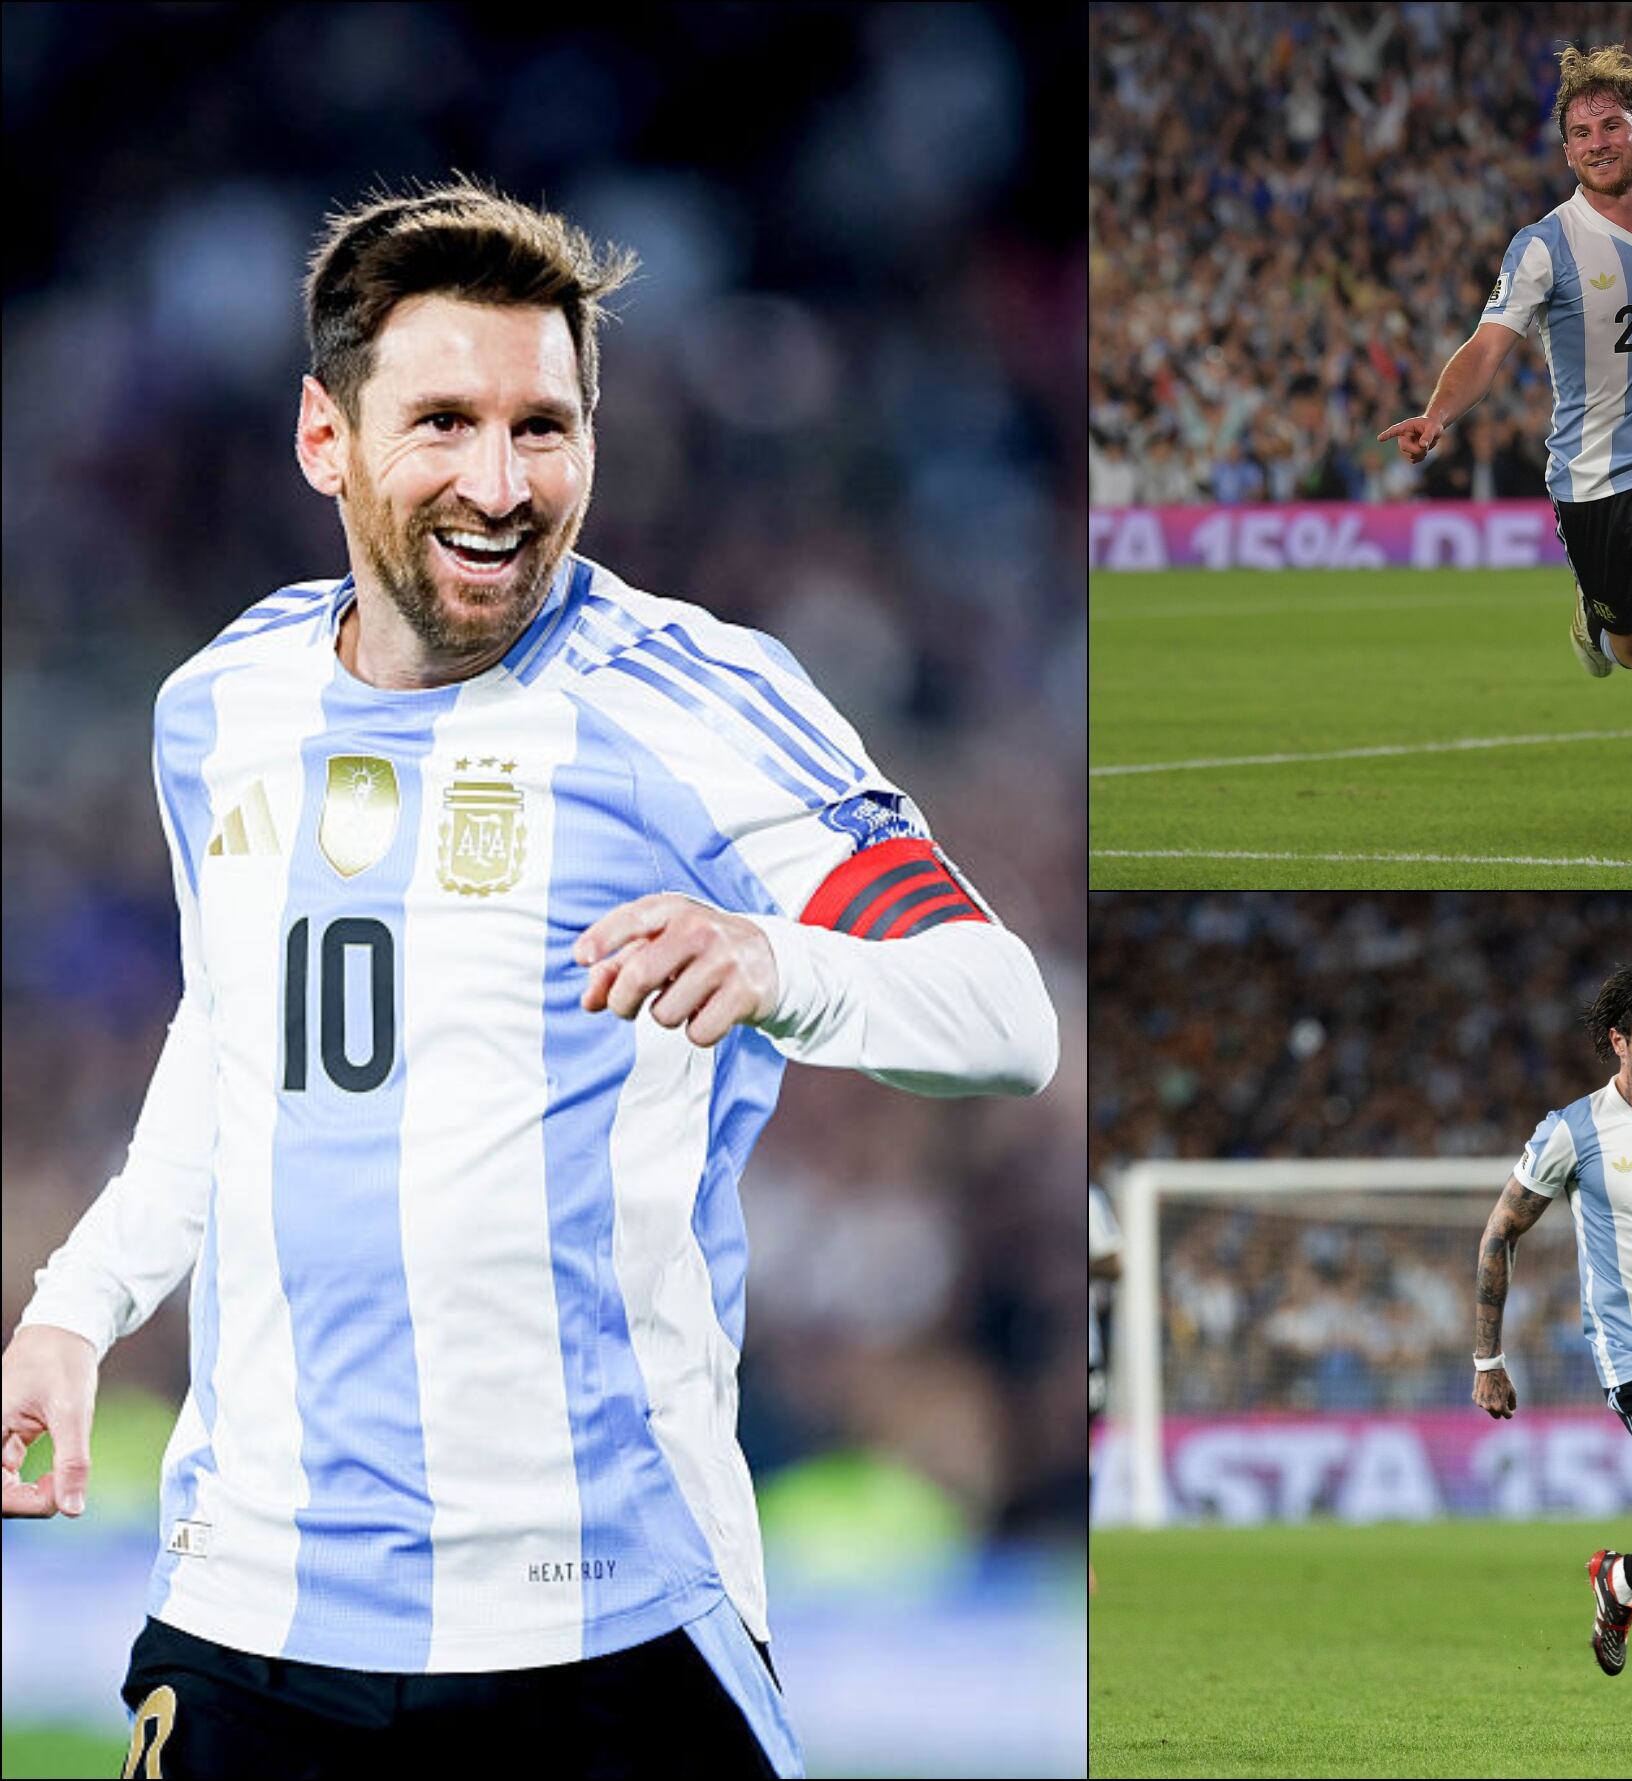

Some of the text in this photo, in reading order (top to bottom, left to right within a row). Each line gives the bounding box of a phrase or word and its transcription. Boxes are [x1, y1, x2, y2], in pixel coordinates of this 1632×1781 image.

[1189, 510, 1388, 570] 15%
[1410, 512, 1545, 567] DE
[456, 814, 506, 867] AFA
[283, 916, 395, 1093] 10
